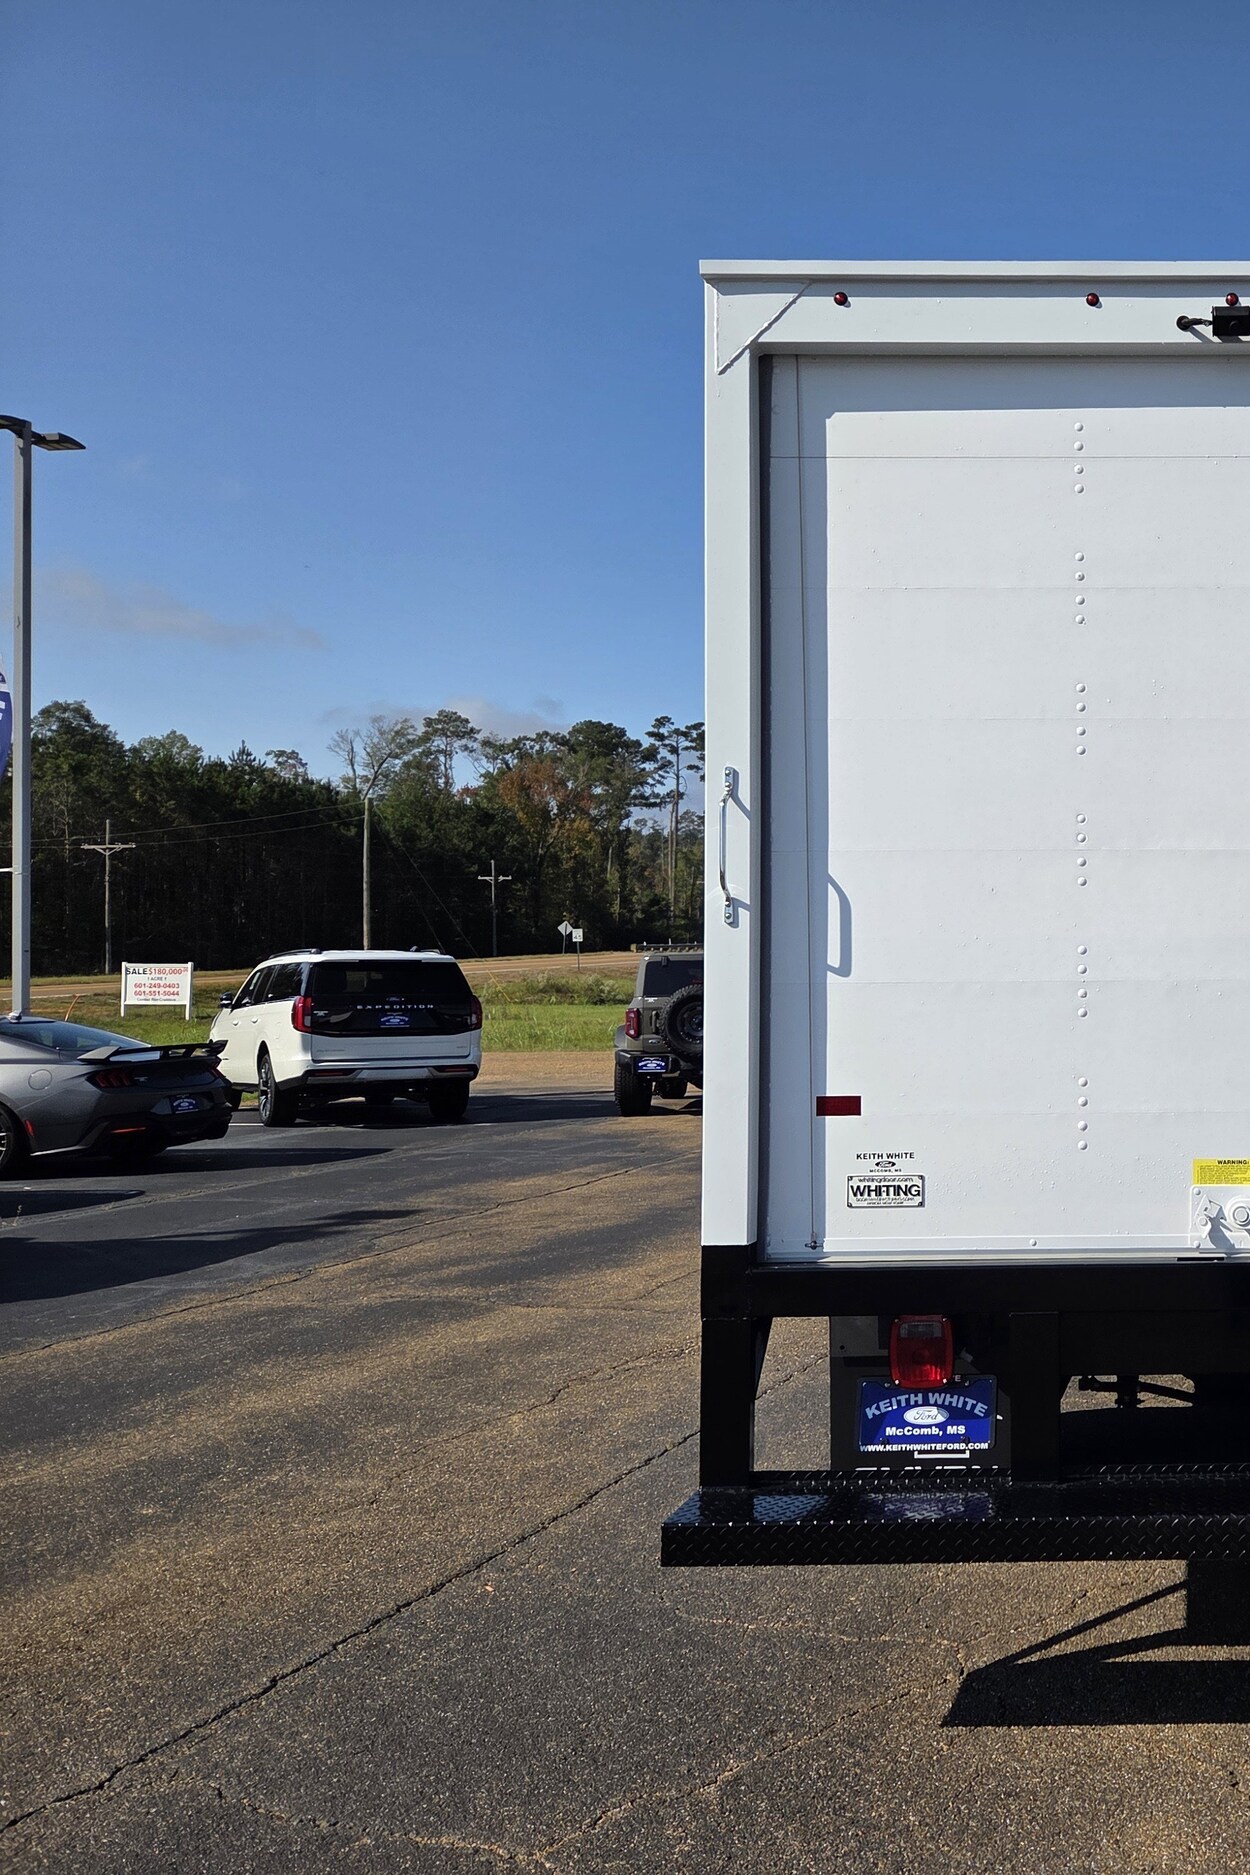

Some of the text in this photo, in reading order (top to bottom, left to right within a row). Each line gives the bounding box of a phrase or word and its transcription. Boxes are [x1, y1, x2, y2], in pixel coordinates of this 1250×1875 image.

[886, 1152, 915, 1160] WHITE
[850, 1184, 921, 1197] WHITING
[865, 1392, 988, 1420] KEITH WHITE
[913, 1409, 939, 1421] Ford
[885, 1425, 966, 1436] McComb, MS
[860, 1442, 989, 1452] WWW.KEITHWHITEFORD.COM
